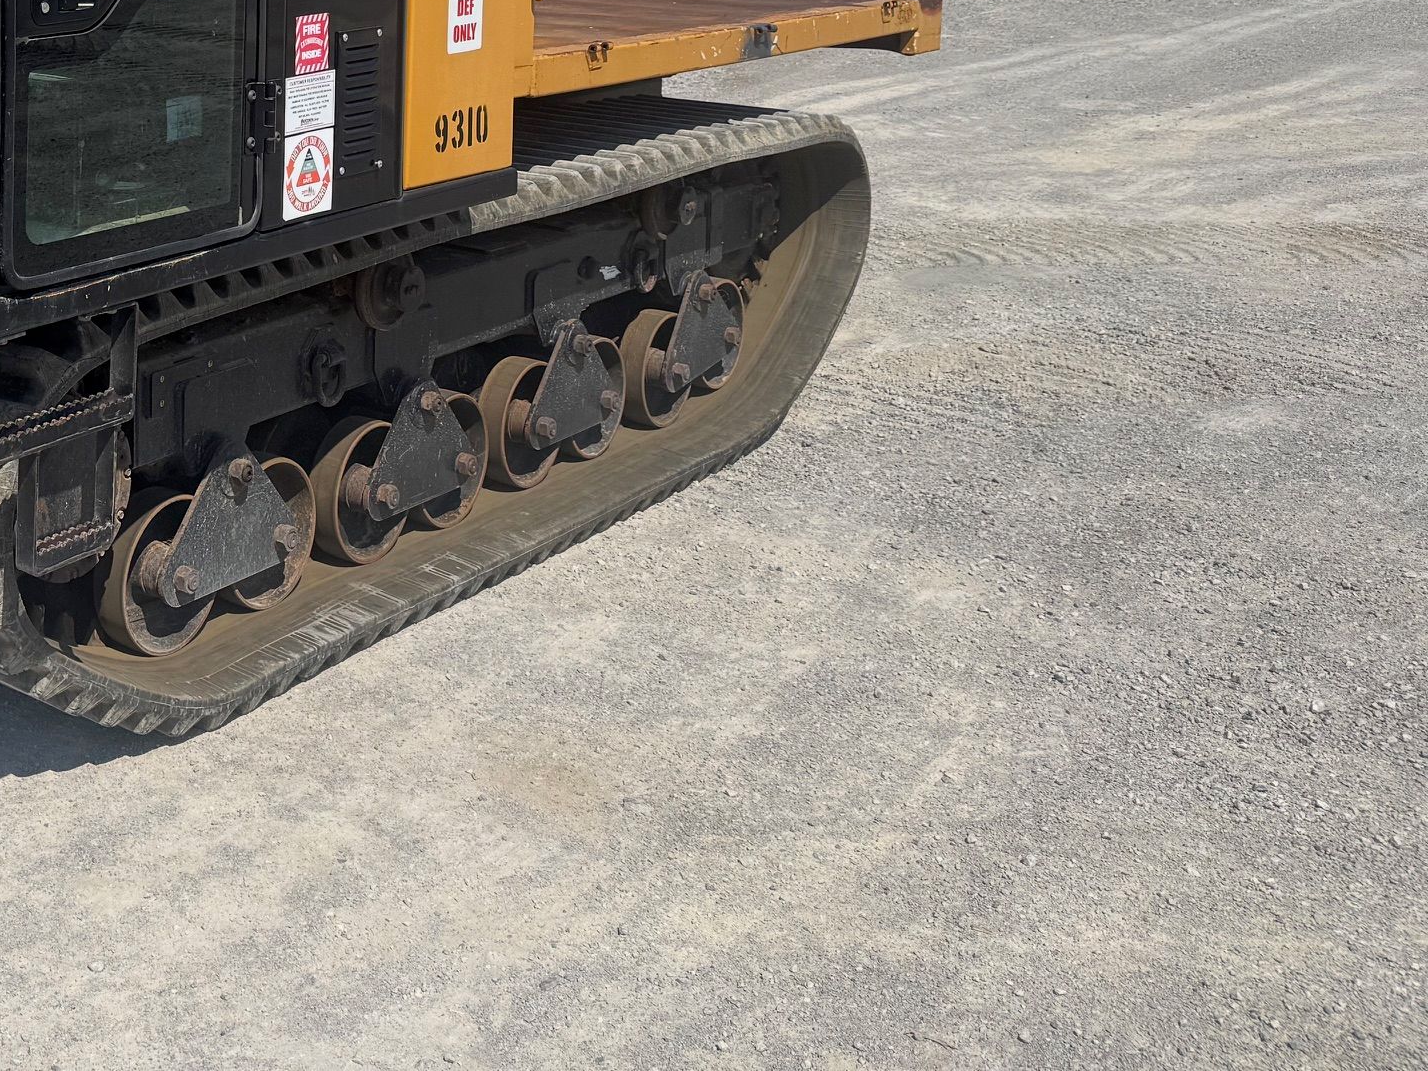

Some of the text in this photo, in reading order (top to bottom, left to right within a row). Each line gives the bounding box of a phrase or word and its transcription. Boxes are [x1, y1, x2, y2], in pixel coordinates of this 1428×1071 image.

[303, 23, 322, 36] FIRE
[453, 22, 477, 44] ONLY
[302, 49, 322, 60] INSIDE
[435, 105, 488, 153] 9310
